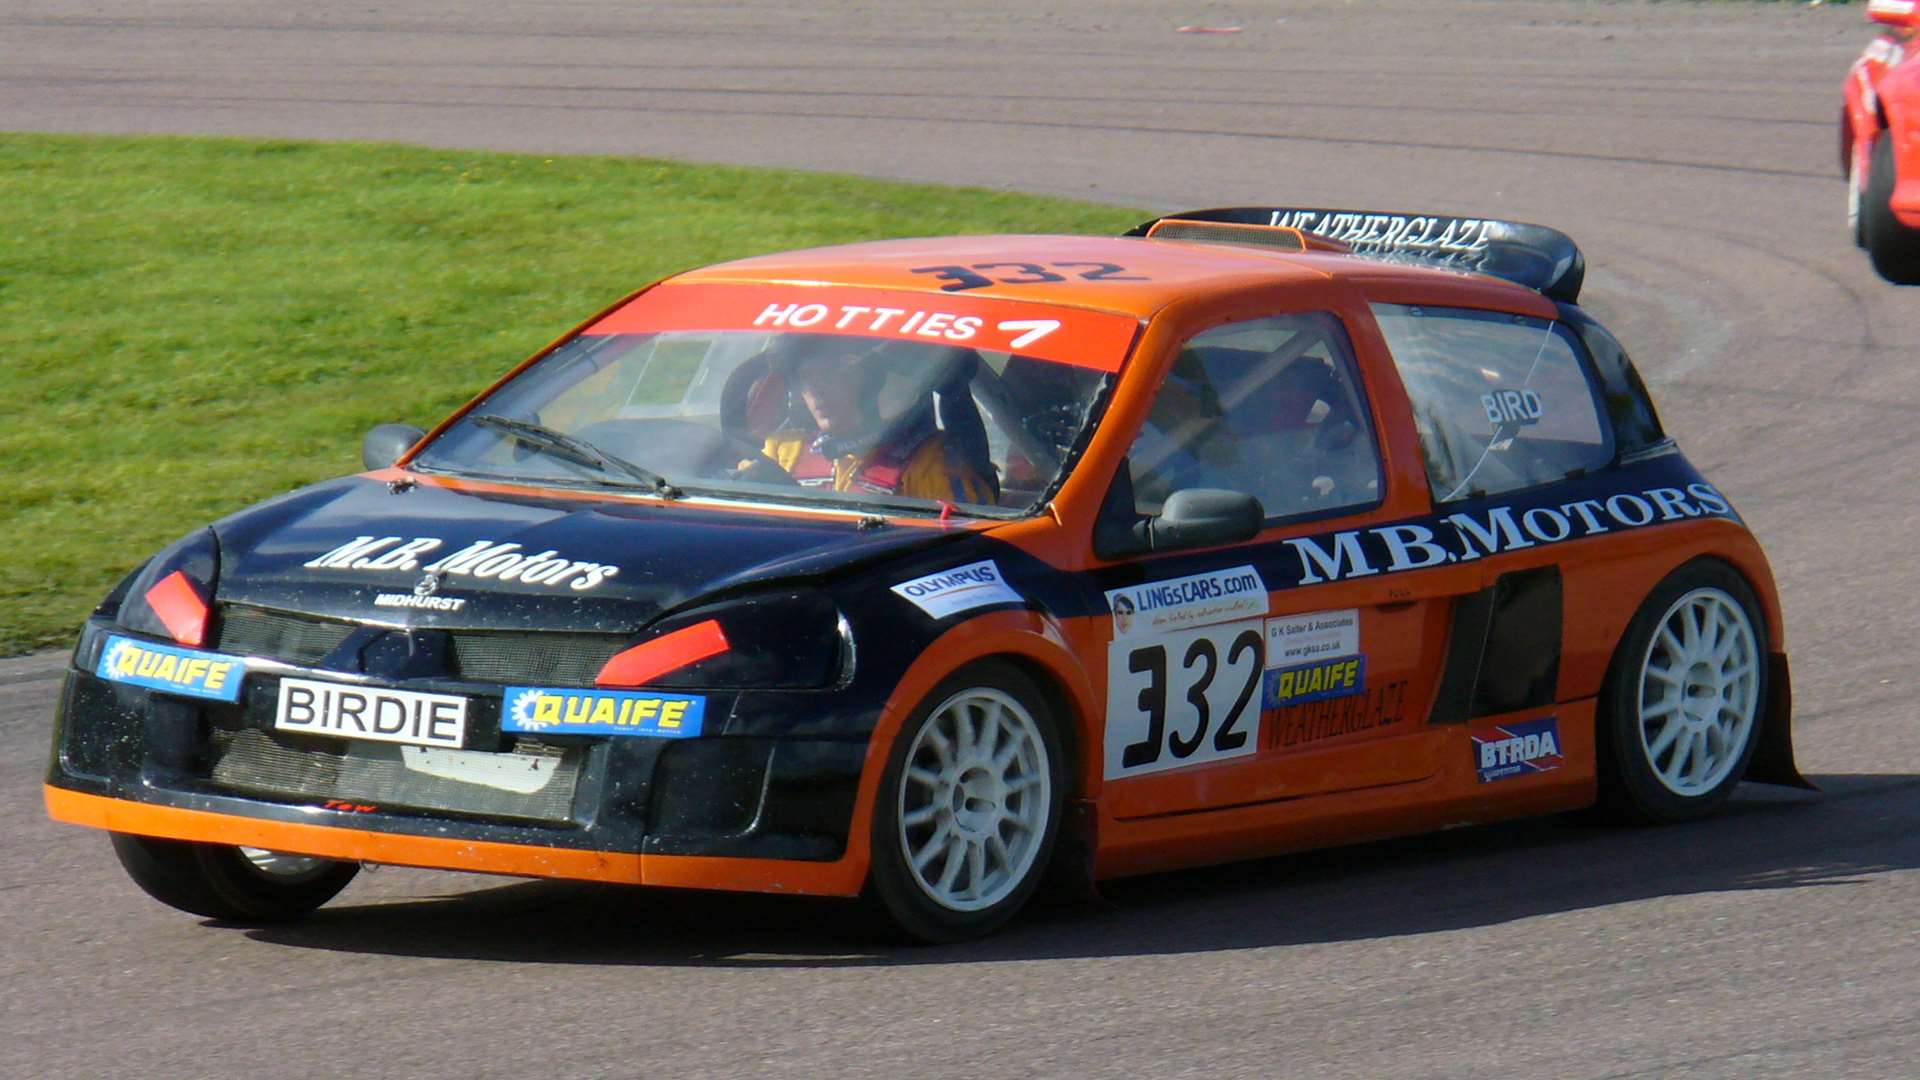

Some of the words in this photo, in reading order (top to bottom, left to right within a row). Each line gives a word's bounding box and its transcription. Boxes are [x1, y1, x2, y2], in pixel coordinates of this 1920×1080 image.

[1269, 210, 1497, 249] WEATHERGLAZE
[910, 262, 1151, 292] 332
[752, 303, 984, 340] HOTTIES
[1481, 390, 1542, 423] BIRD
[303, 536, 442, 571] M.B.
[423, 540, 619, 590] Motors
[904, 566, 996, 597] OLYMPUS
[374, 593, 465, 611] MIDHURST
[1136, 573, 1257, 611] LINGsCARS.com
[1271, 626, 1278, 638] G
[1279, 625, 1285, 636] K
[1308, 622, 1314, 632] &
[1315, 617, 1354, 631] Associates
[117, 646, 231, 690] QUAIFE
[1278, 659, 1360, 699] QUAIFE
[284, 685, 460, 742] BIRDIE
[532, 695, 689, 729] QUAIFE
[1122, 629, 1265, 769] 332
[1481, 730, 1557, 769] BTRDA
